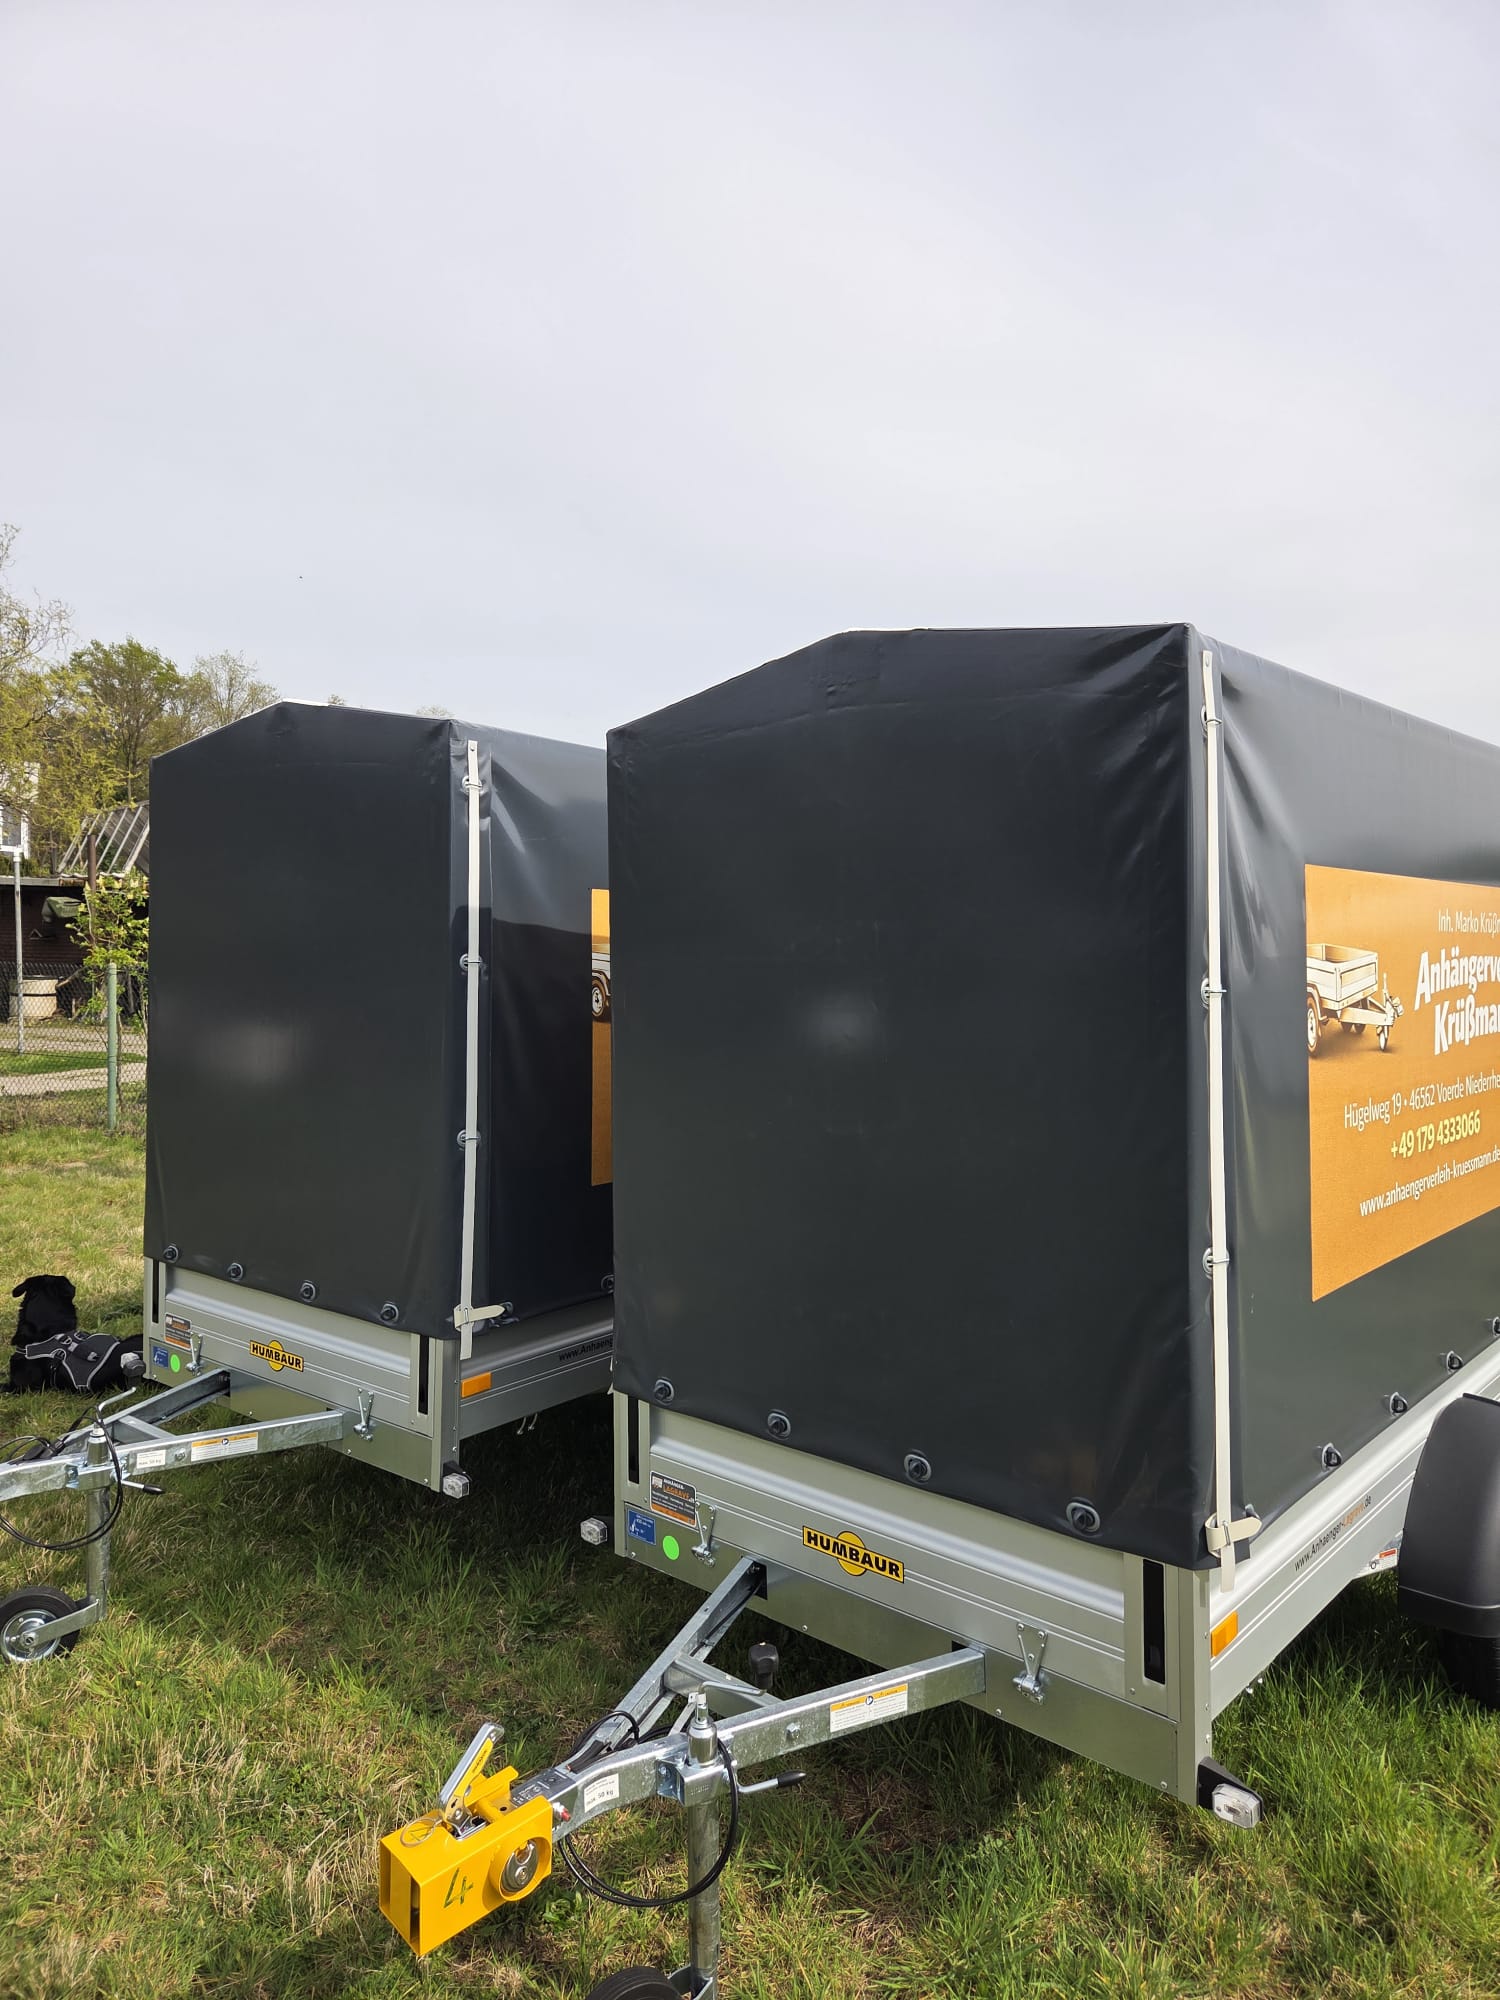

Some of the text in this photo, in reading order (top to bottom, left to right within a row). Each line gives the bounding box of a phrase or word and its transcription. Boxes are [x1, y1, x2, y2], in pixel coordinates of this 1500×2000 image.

[1438, 908, 1454, 932] Inh.
[1455, 910, 1479, 933] Marko
[1344, 1097, 1391, 1131] Hügelweg
[1391, 1092, 1402, 1115] 19
[1409, 1084, 1435, 1111] 46562
[1436, 1077, 1464, 1103] Voerde
[1391, 1110, 1481, 1158] +49 179 4333066
[251, 1343, 302, 1369] HUMBAUR
[807, 1530, 901, 1578] HUMBAUR
[444, 1868, 474, 1908] 4
